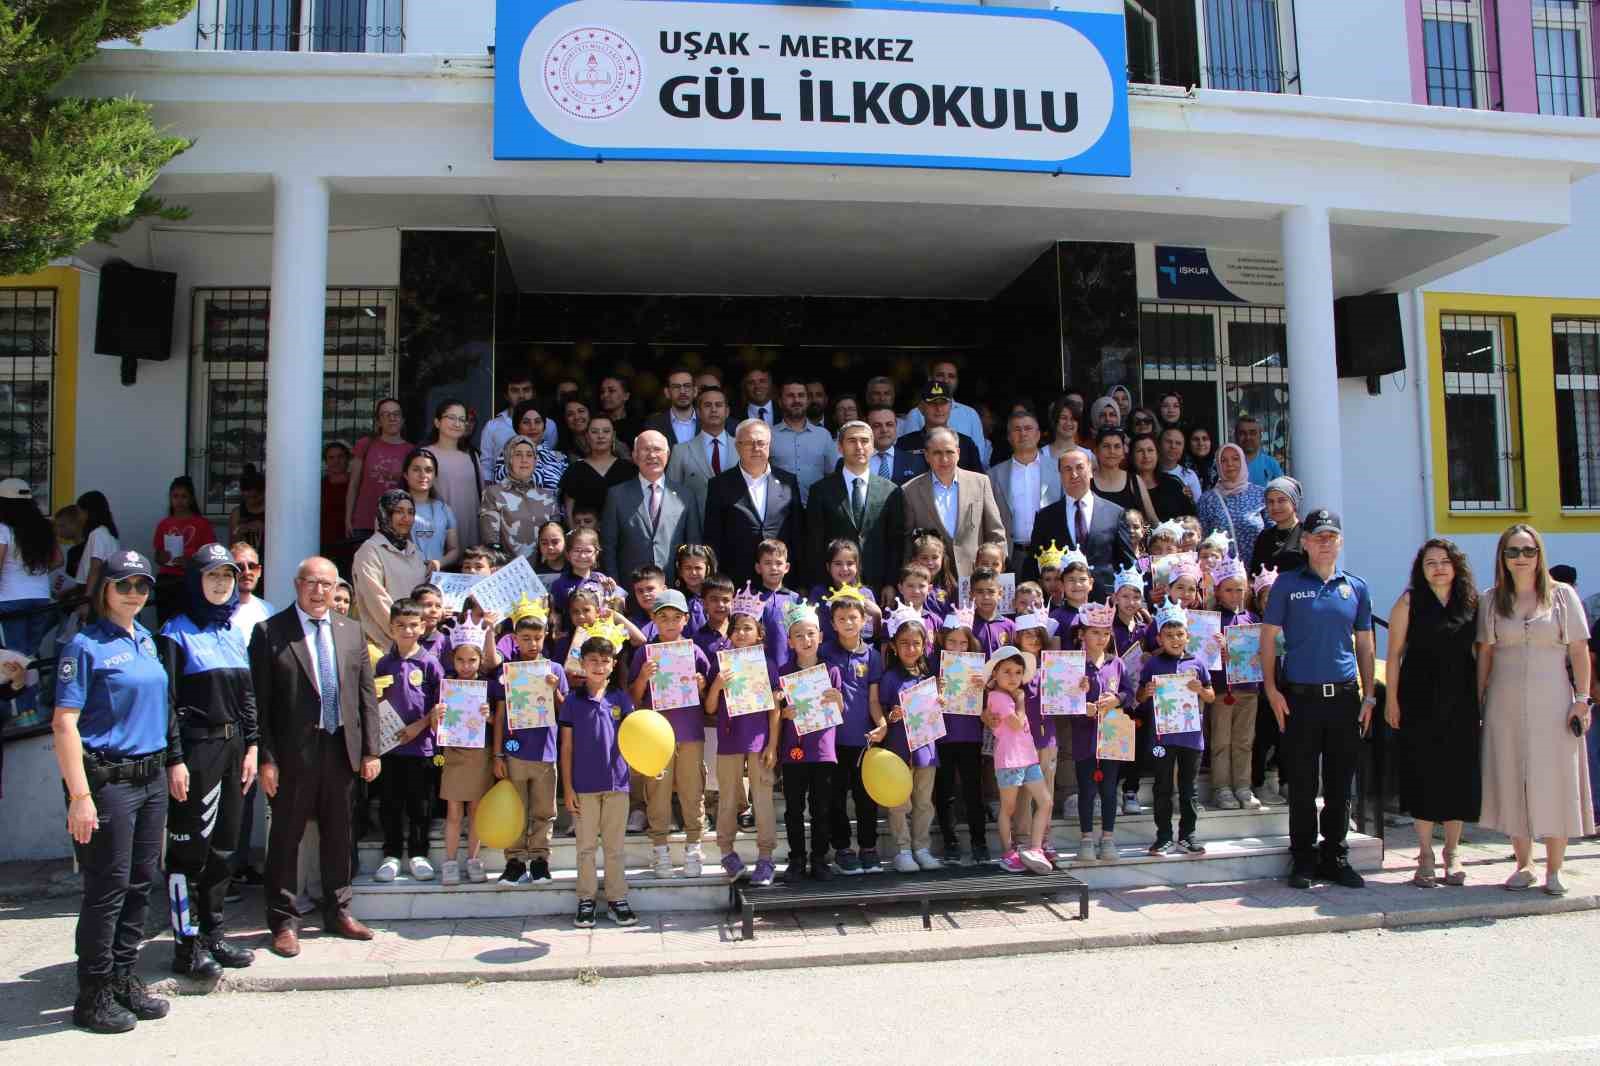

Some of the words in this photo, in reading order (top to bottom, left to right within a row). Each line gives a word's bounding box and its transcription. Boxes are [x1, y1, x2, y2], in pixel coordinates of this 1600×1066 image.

[659, 30, 750, 61] UŞAK
[779, 34, 914, 63] MERKEZ
[659, 66, 782, 121] GÜL
[799, 69, 1079, 133] İLKOKULU
